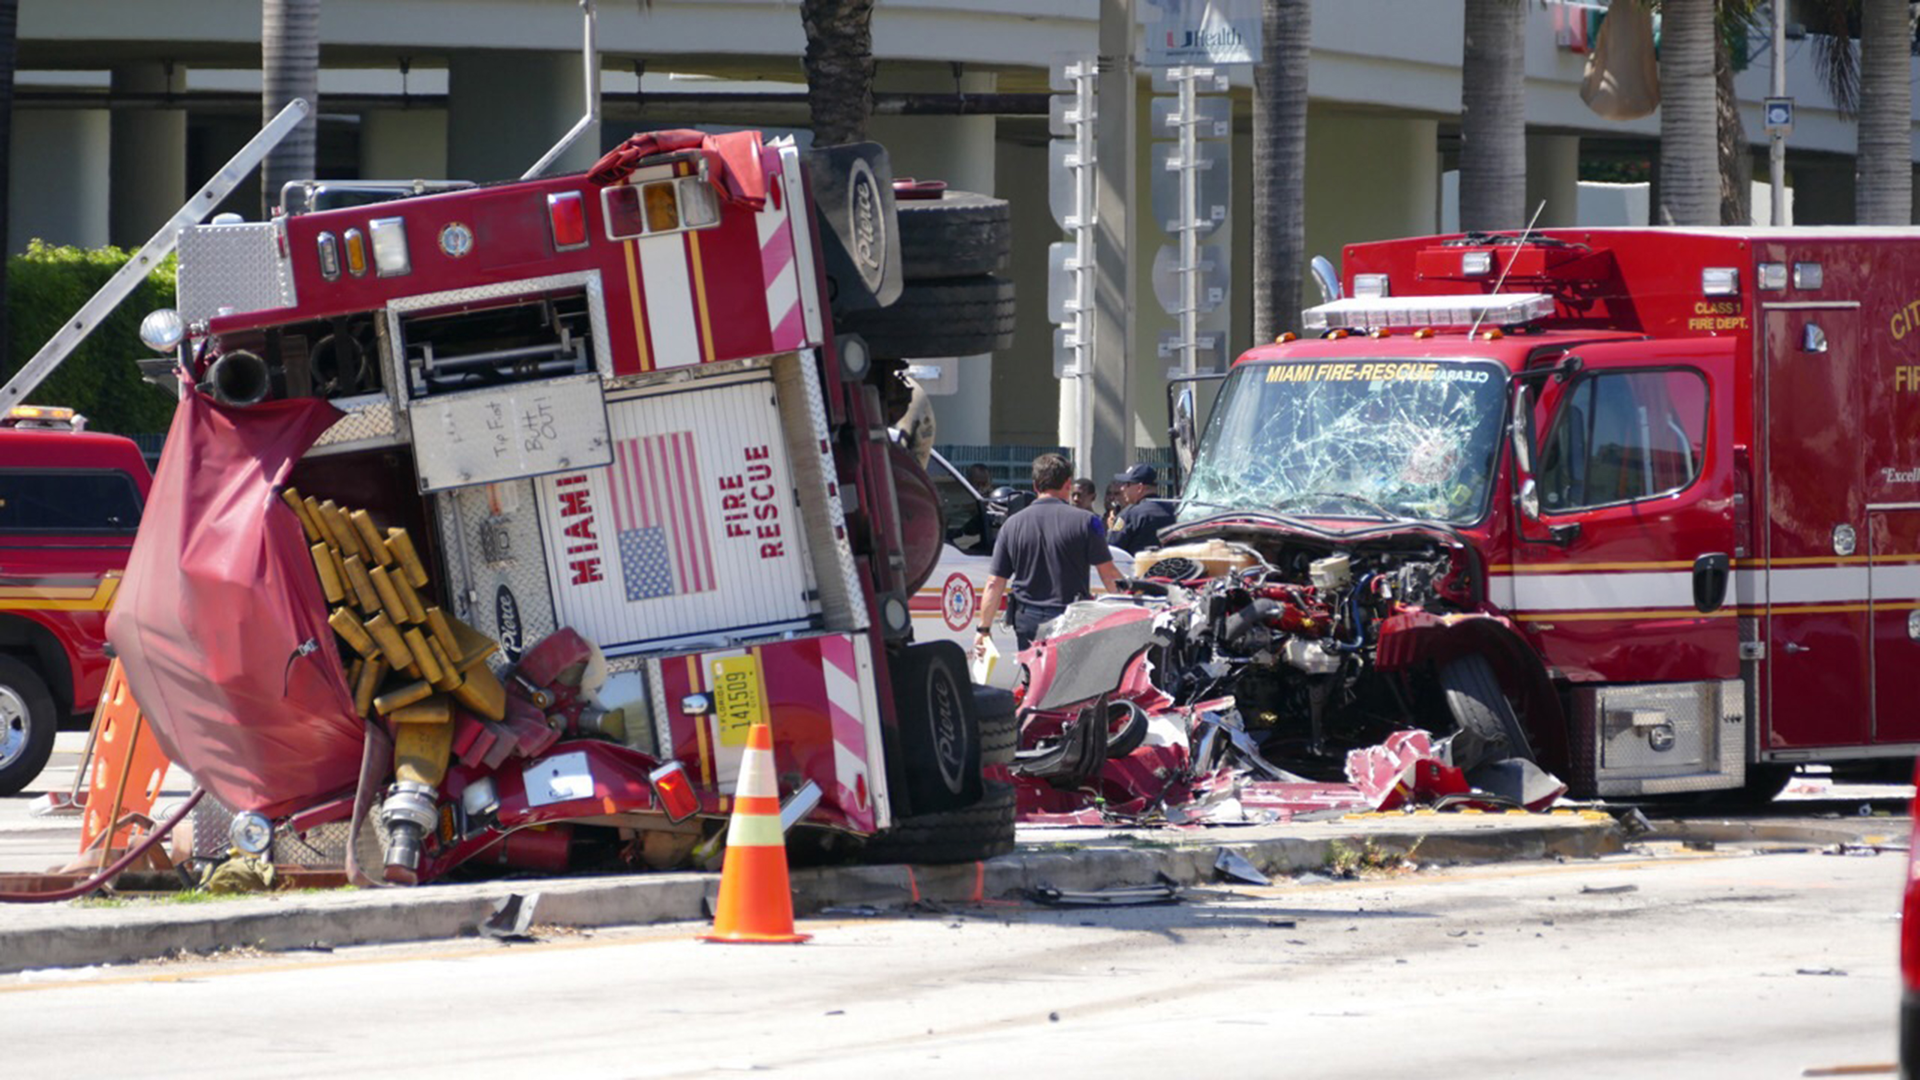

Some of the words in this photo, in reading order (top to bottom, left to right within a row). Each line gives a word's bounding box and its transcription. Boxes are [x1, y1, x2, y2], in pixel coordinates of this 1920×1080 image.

[857, 182, 879, 270] Pierce
[1689, 318, 1715, 330] FIRE
[1716, 317, 1749, 330] DEPT.
[1695, 302, 1733, 314] CLASS
[1736, 303, 1741, 313] 1
[1265, 365, 1315, 383] MIAMI
[1315, 362, 1438, 382] FIRE-RESCUE
[522, 411, 544, 453] Butt
[556, 474, 603, 585] MIAMI
[719, 474, 751, 537] FIRE
[745, 445, 785, 559] RESCUE
[500, 594, 522, 653] Pierce
[726, 671, 751, 729] 141509
[935, 680, 960, 766] Pierce
